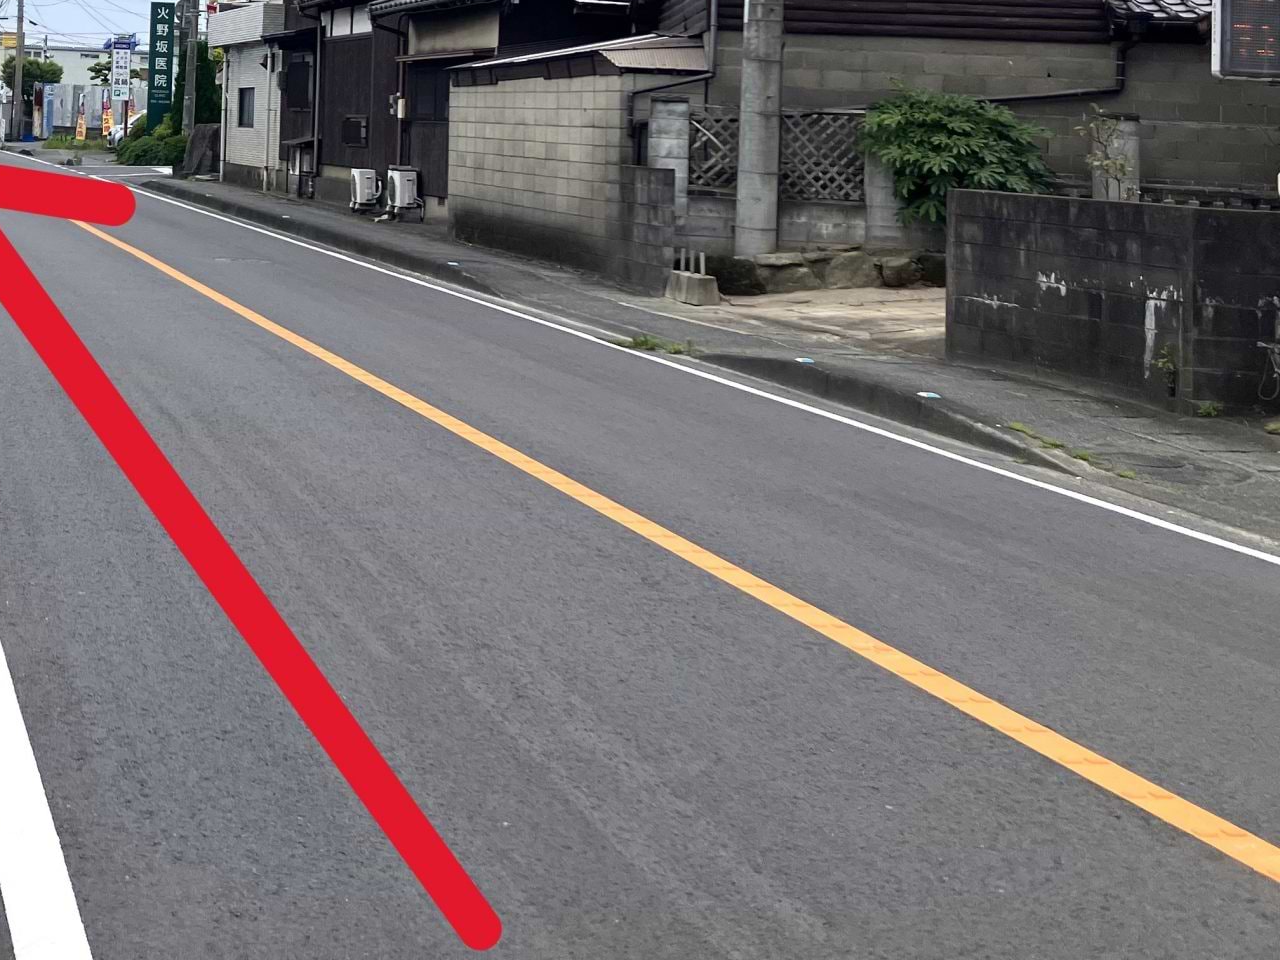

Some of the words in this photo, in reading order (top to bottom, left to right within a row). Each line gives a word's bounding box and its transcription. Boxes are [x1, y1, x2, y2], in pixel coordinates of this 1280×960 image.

[154, 6, 169, 87] 火野坂医院
